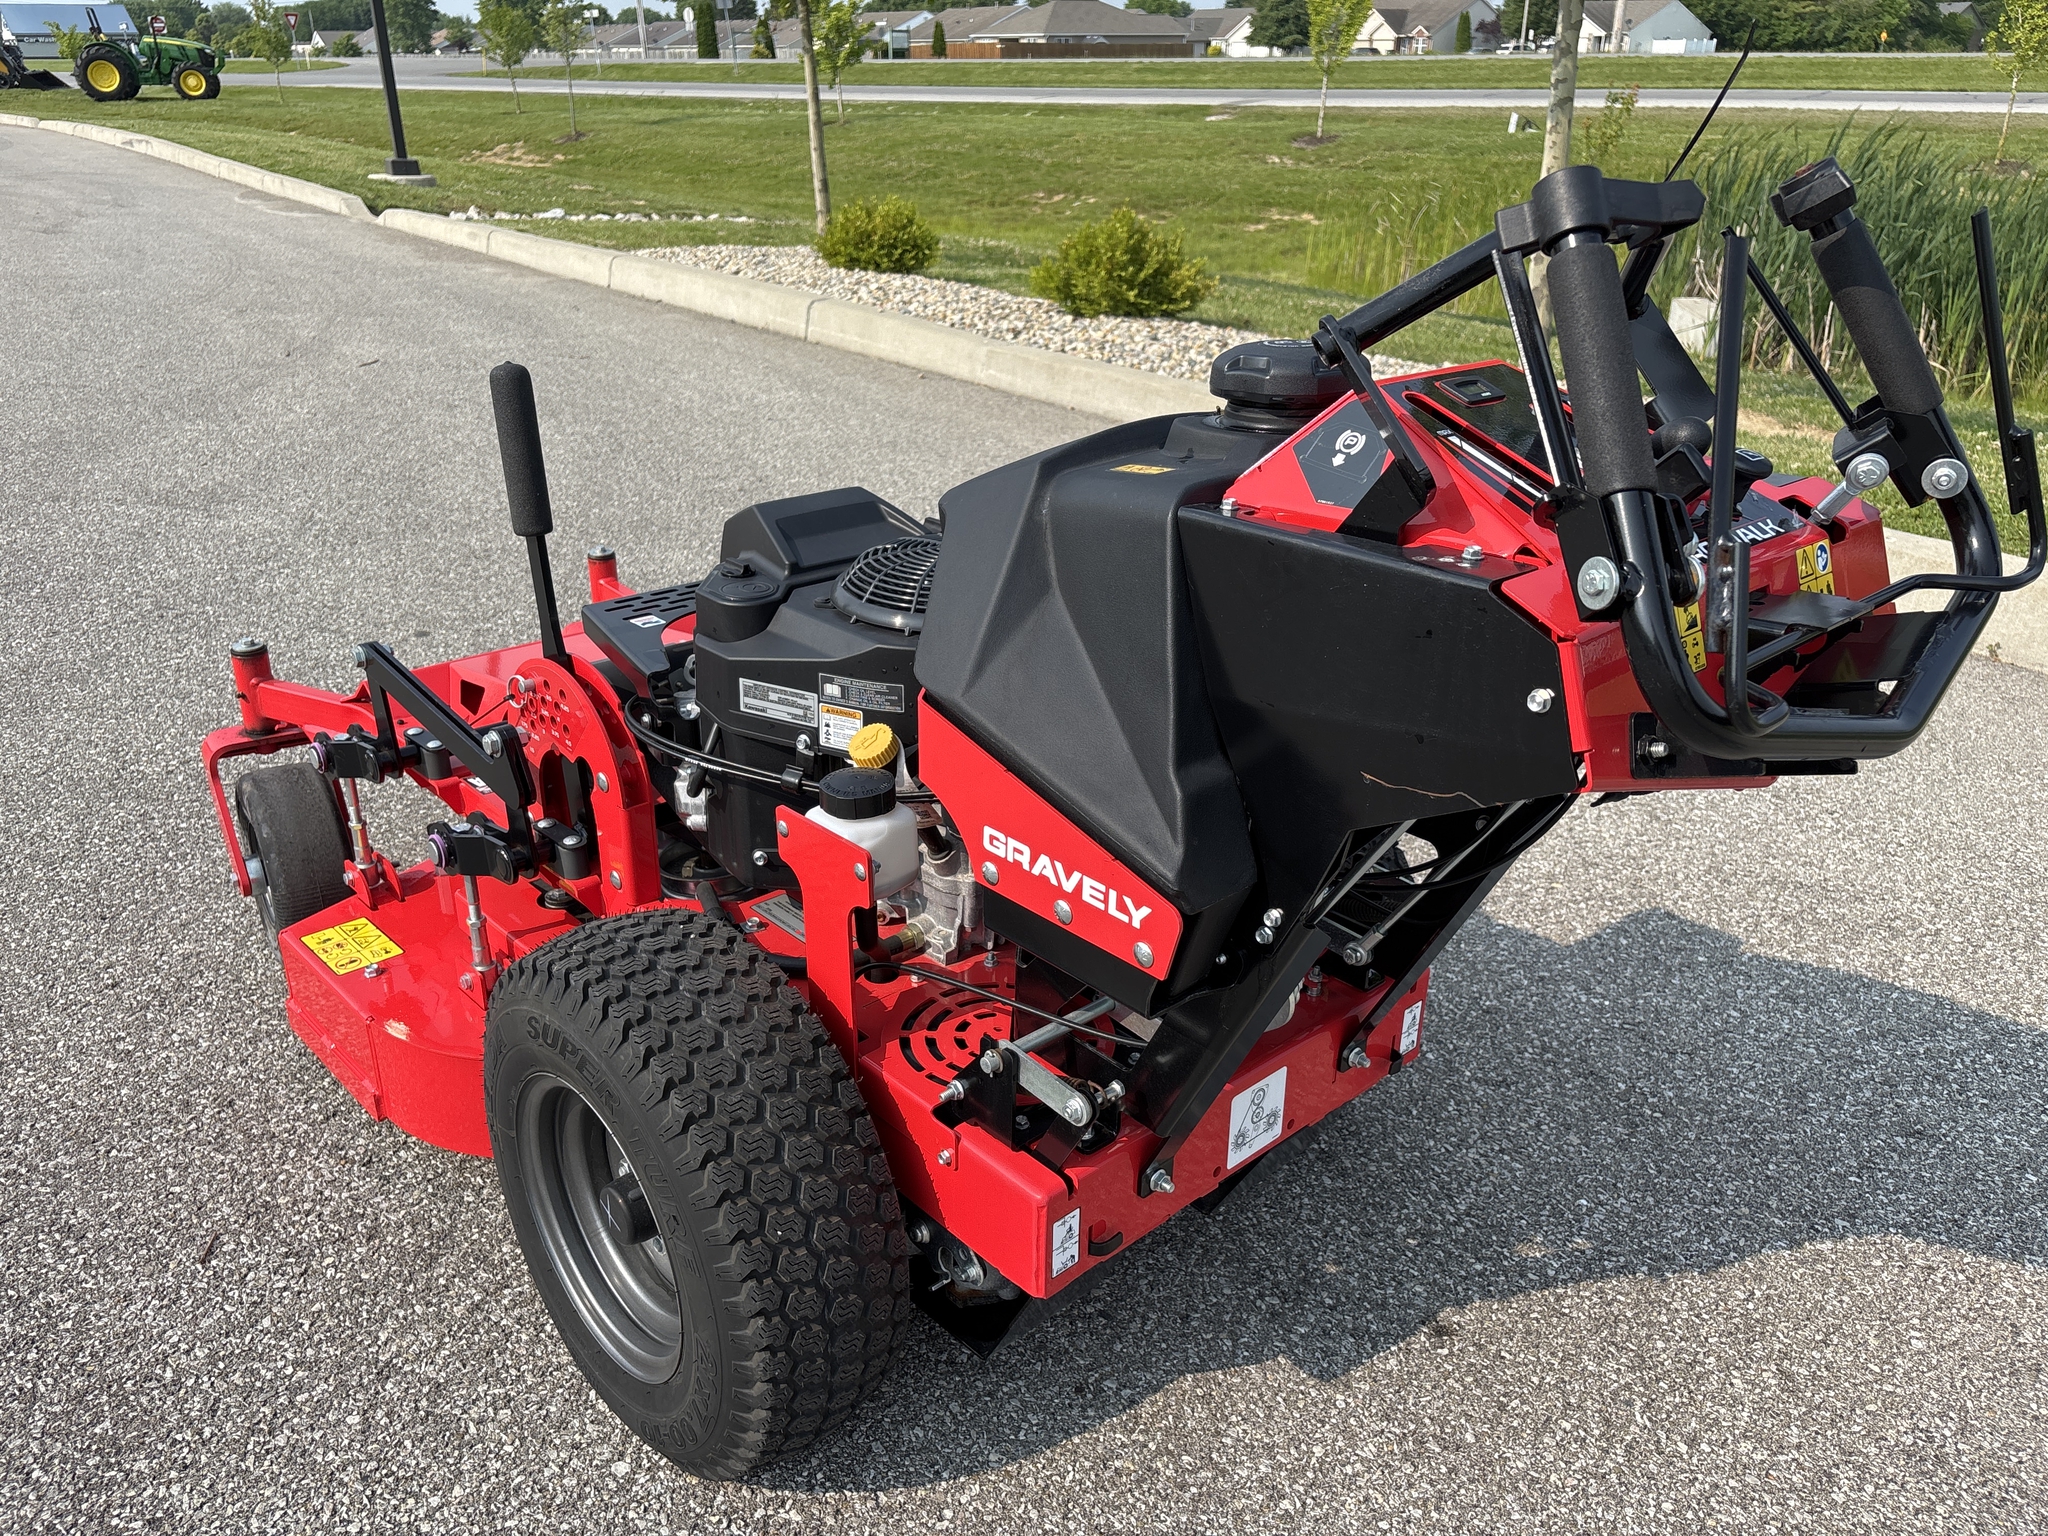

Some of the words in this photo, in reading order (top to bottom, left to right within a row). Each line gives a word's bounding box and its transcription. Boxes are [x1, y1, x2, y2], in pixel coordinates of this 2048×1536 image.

[1730, 518, 1786, 545] ALK
[982, 825, 1152, 930] GRAVELY
[526, 1015, 621, 1116] SUPER
[629, 1126, 702, 1279] TURF
